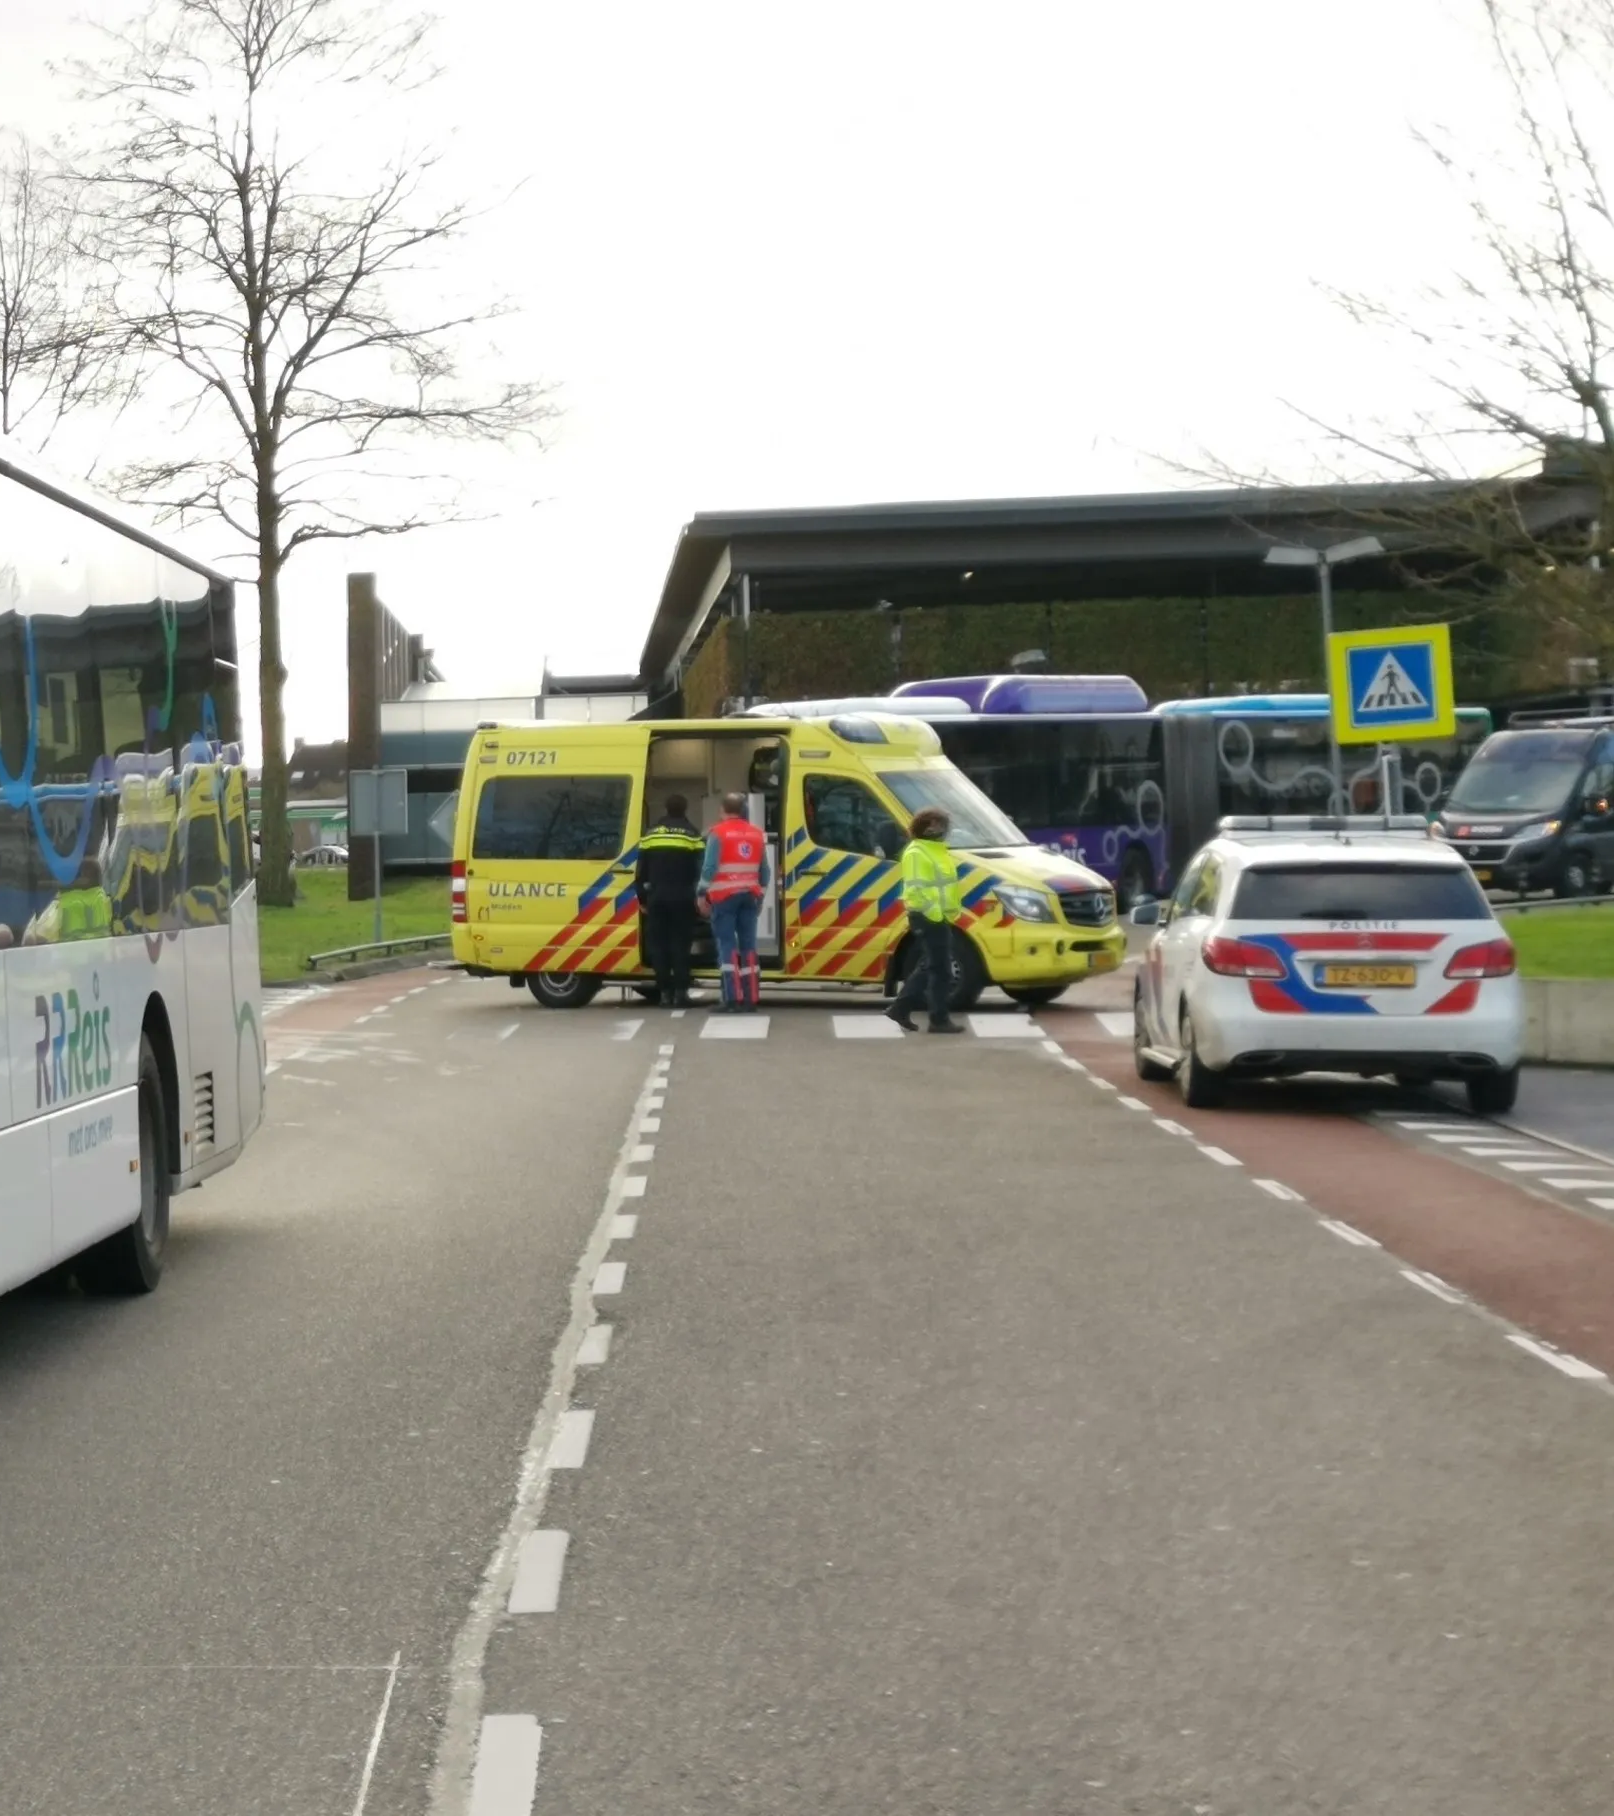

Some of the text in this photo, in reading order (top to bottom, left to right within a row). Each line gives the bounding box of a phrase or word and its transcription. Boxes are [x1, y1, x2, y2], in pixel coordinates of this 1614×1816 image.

[506, 751, 557, 766] 07121
[489, 883, 567, 897] ULANCE
[1328, 921, 1399, 930] POLITIE
[35, 970, 112, 1109] RRReis
